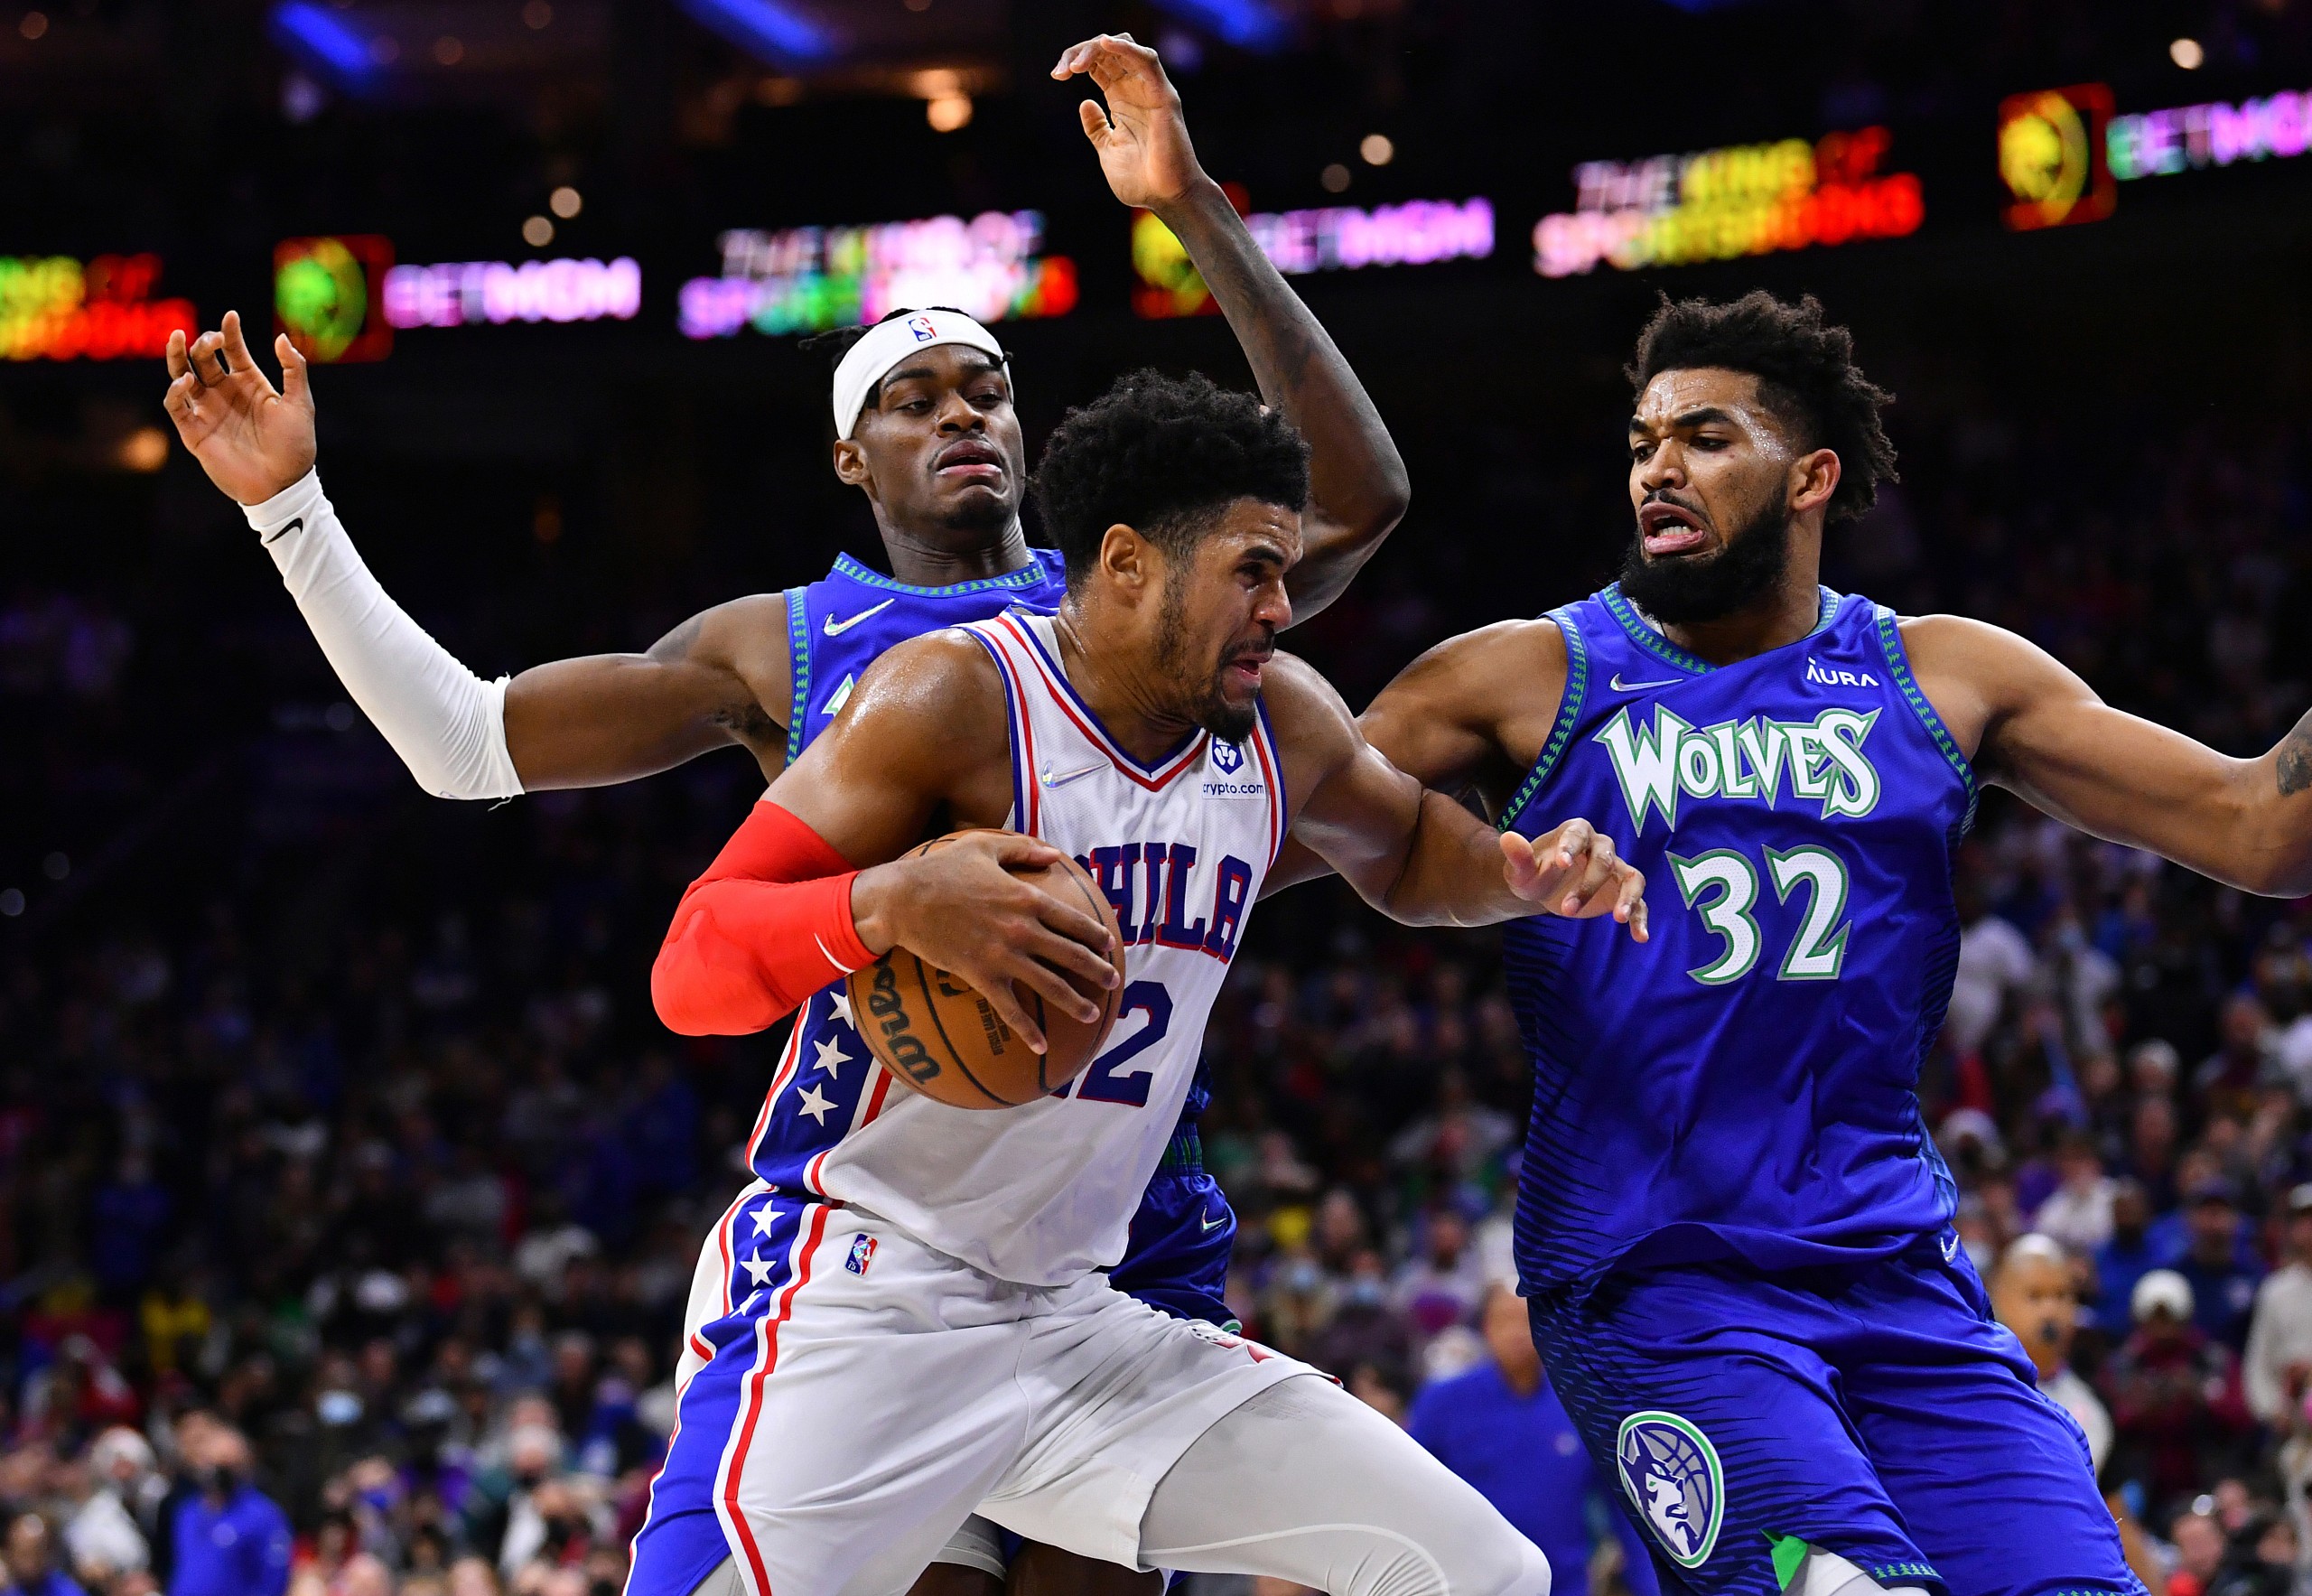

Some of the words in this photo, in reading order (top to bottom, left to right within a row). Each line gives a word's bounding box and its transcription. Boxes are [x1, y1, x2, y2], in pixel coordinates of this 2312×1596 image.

[2107, 89, 2312, 180] BETMG
[1592, 702, 1883, 838] WOLVES
[1074, 843, 1253, 965] HILA
[1664, 844, 1852, 986] 32
[868, 947, 942, 1085] Wils
[1050, 980, 1174, 1108] 2
[847, 1260, 857, 1271] 75
